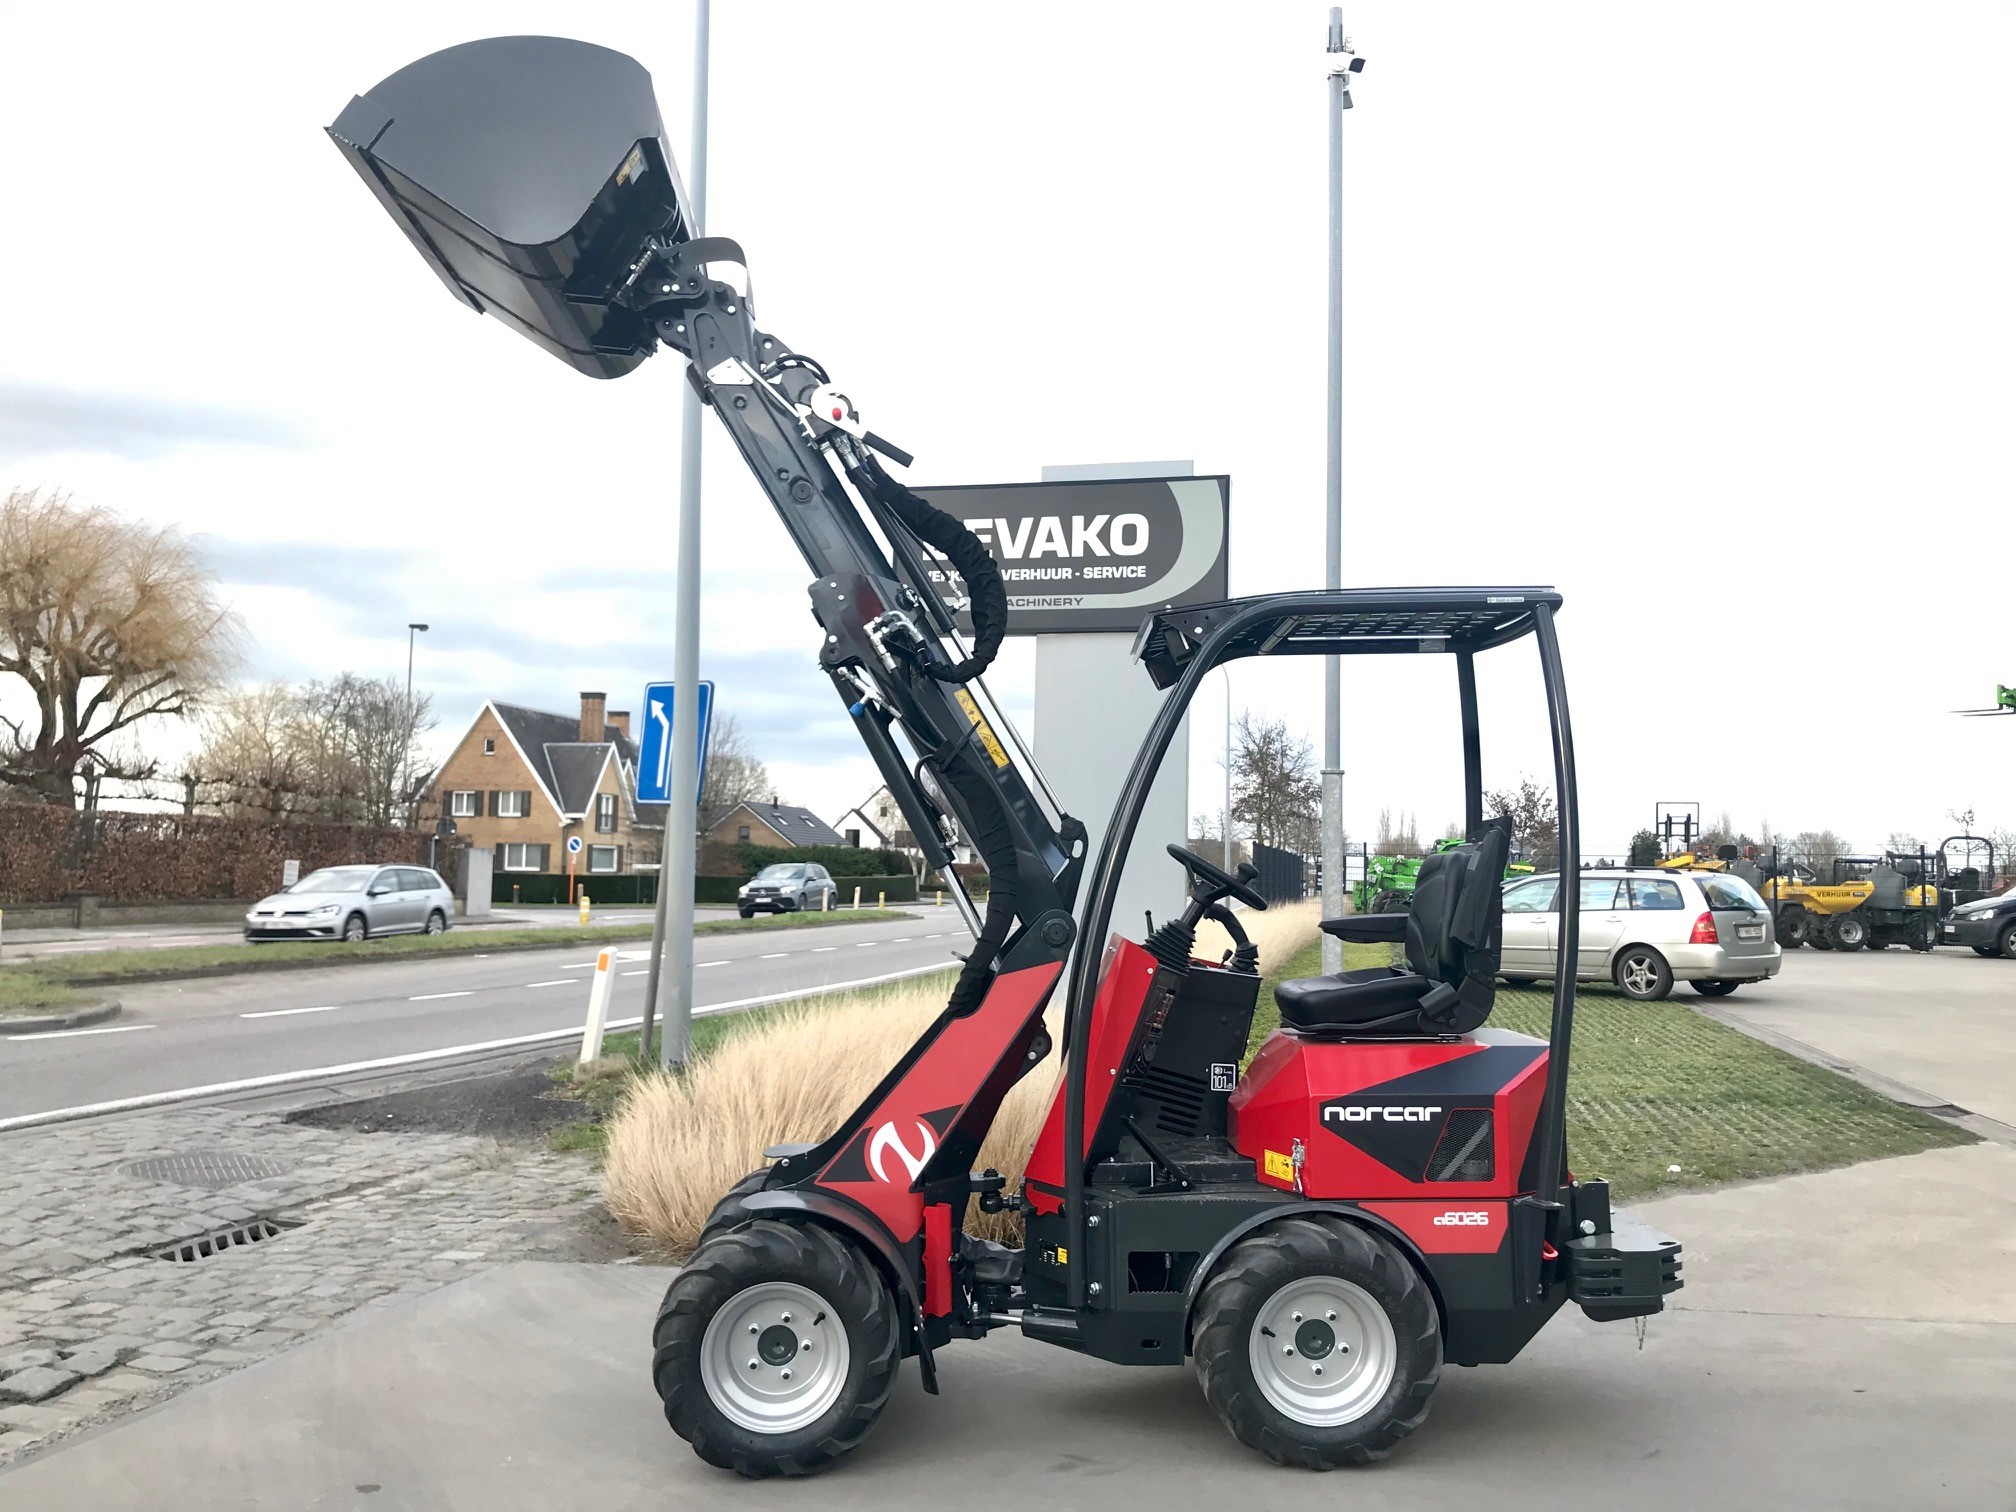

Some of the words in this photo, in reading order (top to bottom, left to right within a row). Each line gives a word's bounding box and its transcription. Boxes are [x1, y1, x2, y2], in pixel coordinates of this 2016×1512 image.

[1001, 568, 1072, 581] VERHUUR
[1083, 565, 1146, 579] SERVICE
[1007, 597, 1084, 607] ACHINERY
[1324, 1106, 1441, 1121] norcar
[1433, 1211, 1489, 1225] a6026
